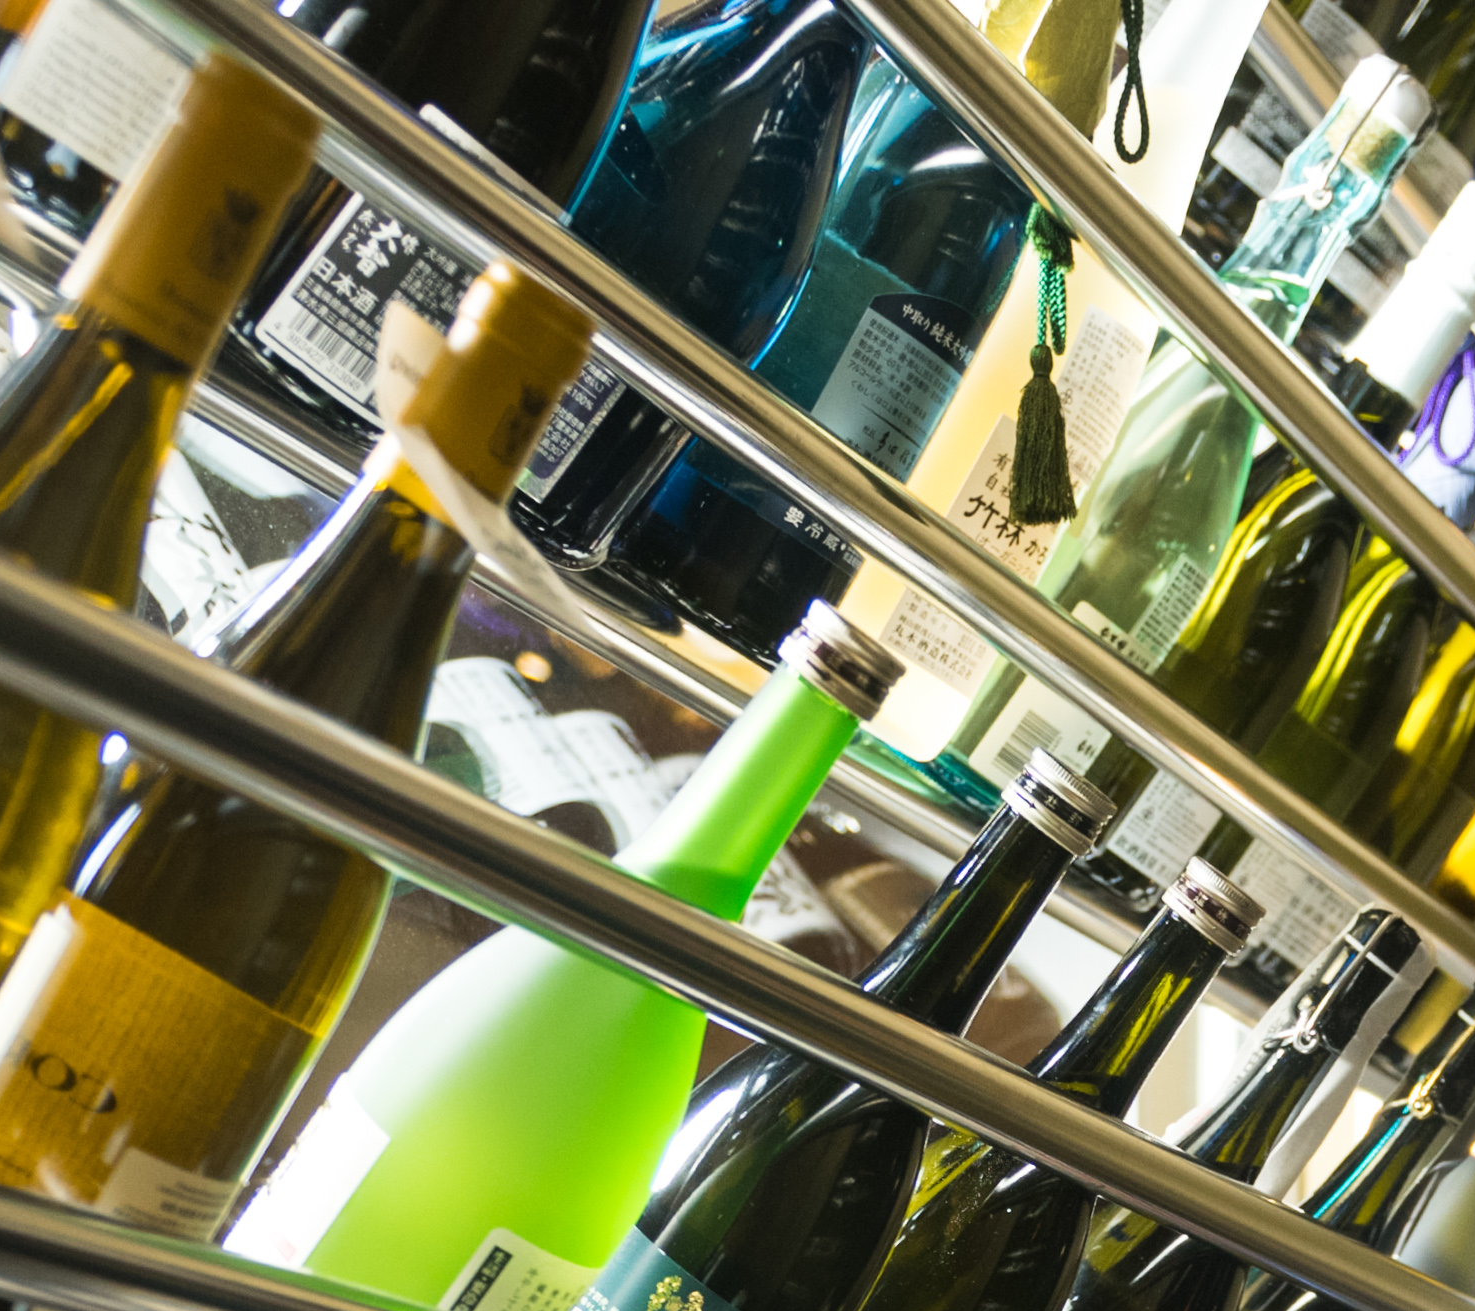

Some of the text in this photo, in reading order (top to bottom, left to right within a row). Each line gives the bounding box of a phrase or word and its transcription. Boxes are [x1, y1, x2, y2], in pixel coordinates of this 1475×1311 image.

[310, 254, 380, 317] 日本酒
[899, 301, 933, 331] 中取り
[963, 494, 1025, 549] 竹林
